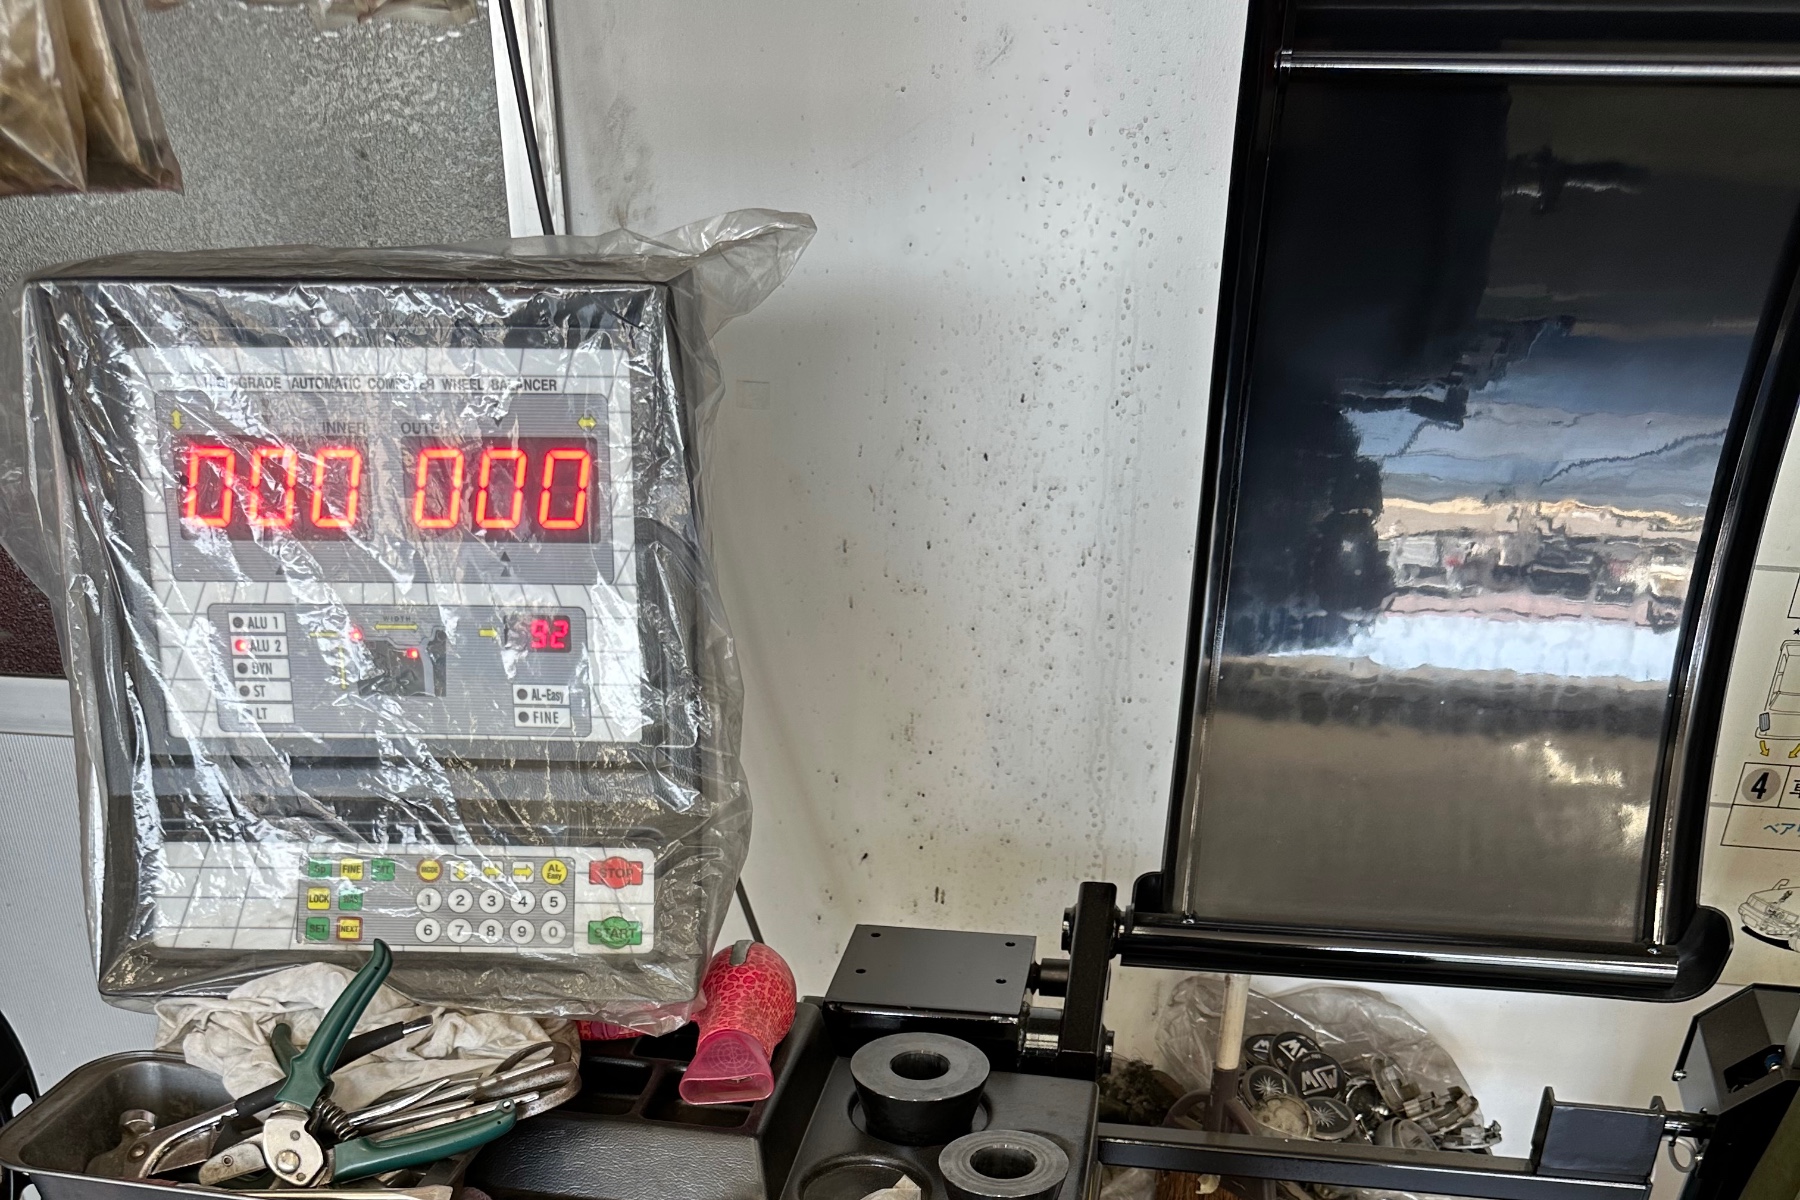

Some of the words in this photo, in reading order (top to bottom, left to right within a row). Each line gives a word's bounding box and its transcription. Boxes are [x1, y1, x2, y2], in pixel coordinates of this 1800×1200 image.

[291, 376, 361, 390] AUTOMATIC
[368, 377, 434, 390] COMER
[442, 378, 484, 391] WHEEL
[491, 378, 557, 391] BANCER
[400, 421, 448, 435] OUTE
[413, 448, 592, 529] 000
[248, 617, 267, 629] ALU
[273, 617, 278, 629] 1
[250, 640, 270, 652] ALU
[275, 640, 281, 652] 2
[252, 663, 272, 675] DYN
[254, 686, 266, 698] ST
[531, 688, 564, 703] AL-Easy
[256, 708, 267, 720] LT
[533, 711, 559, 724] FINE
[1750, 772, 1770, 799] 4
[342, 864, 361, 873] FINE
[548, 864, 561, 872] AL
[600, 868, 634, 879] STOP
[547, 873, 562, 881] Easy
[309, 895, 330, 903] LOCK
[456, 895, 465, 906] 2
[487, 895, 496, 906] 3
[518, 896, 528, 907] 4
[550, 897, 558, 908] 5
[310, 924, 326, 933] SET
[341, 925, 359, 933] NEXT
[424, 925, 432, 936] 6
[455, 925, 464, 936] 7
[486, 926, 495, 937] 8
[517, 926, 526, 937] 9
[549, 927, 558, 938] 0
[594, 927, 637, 939] START
